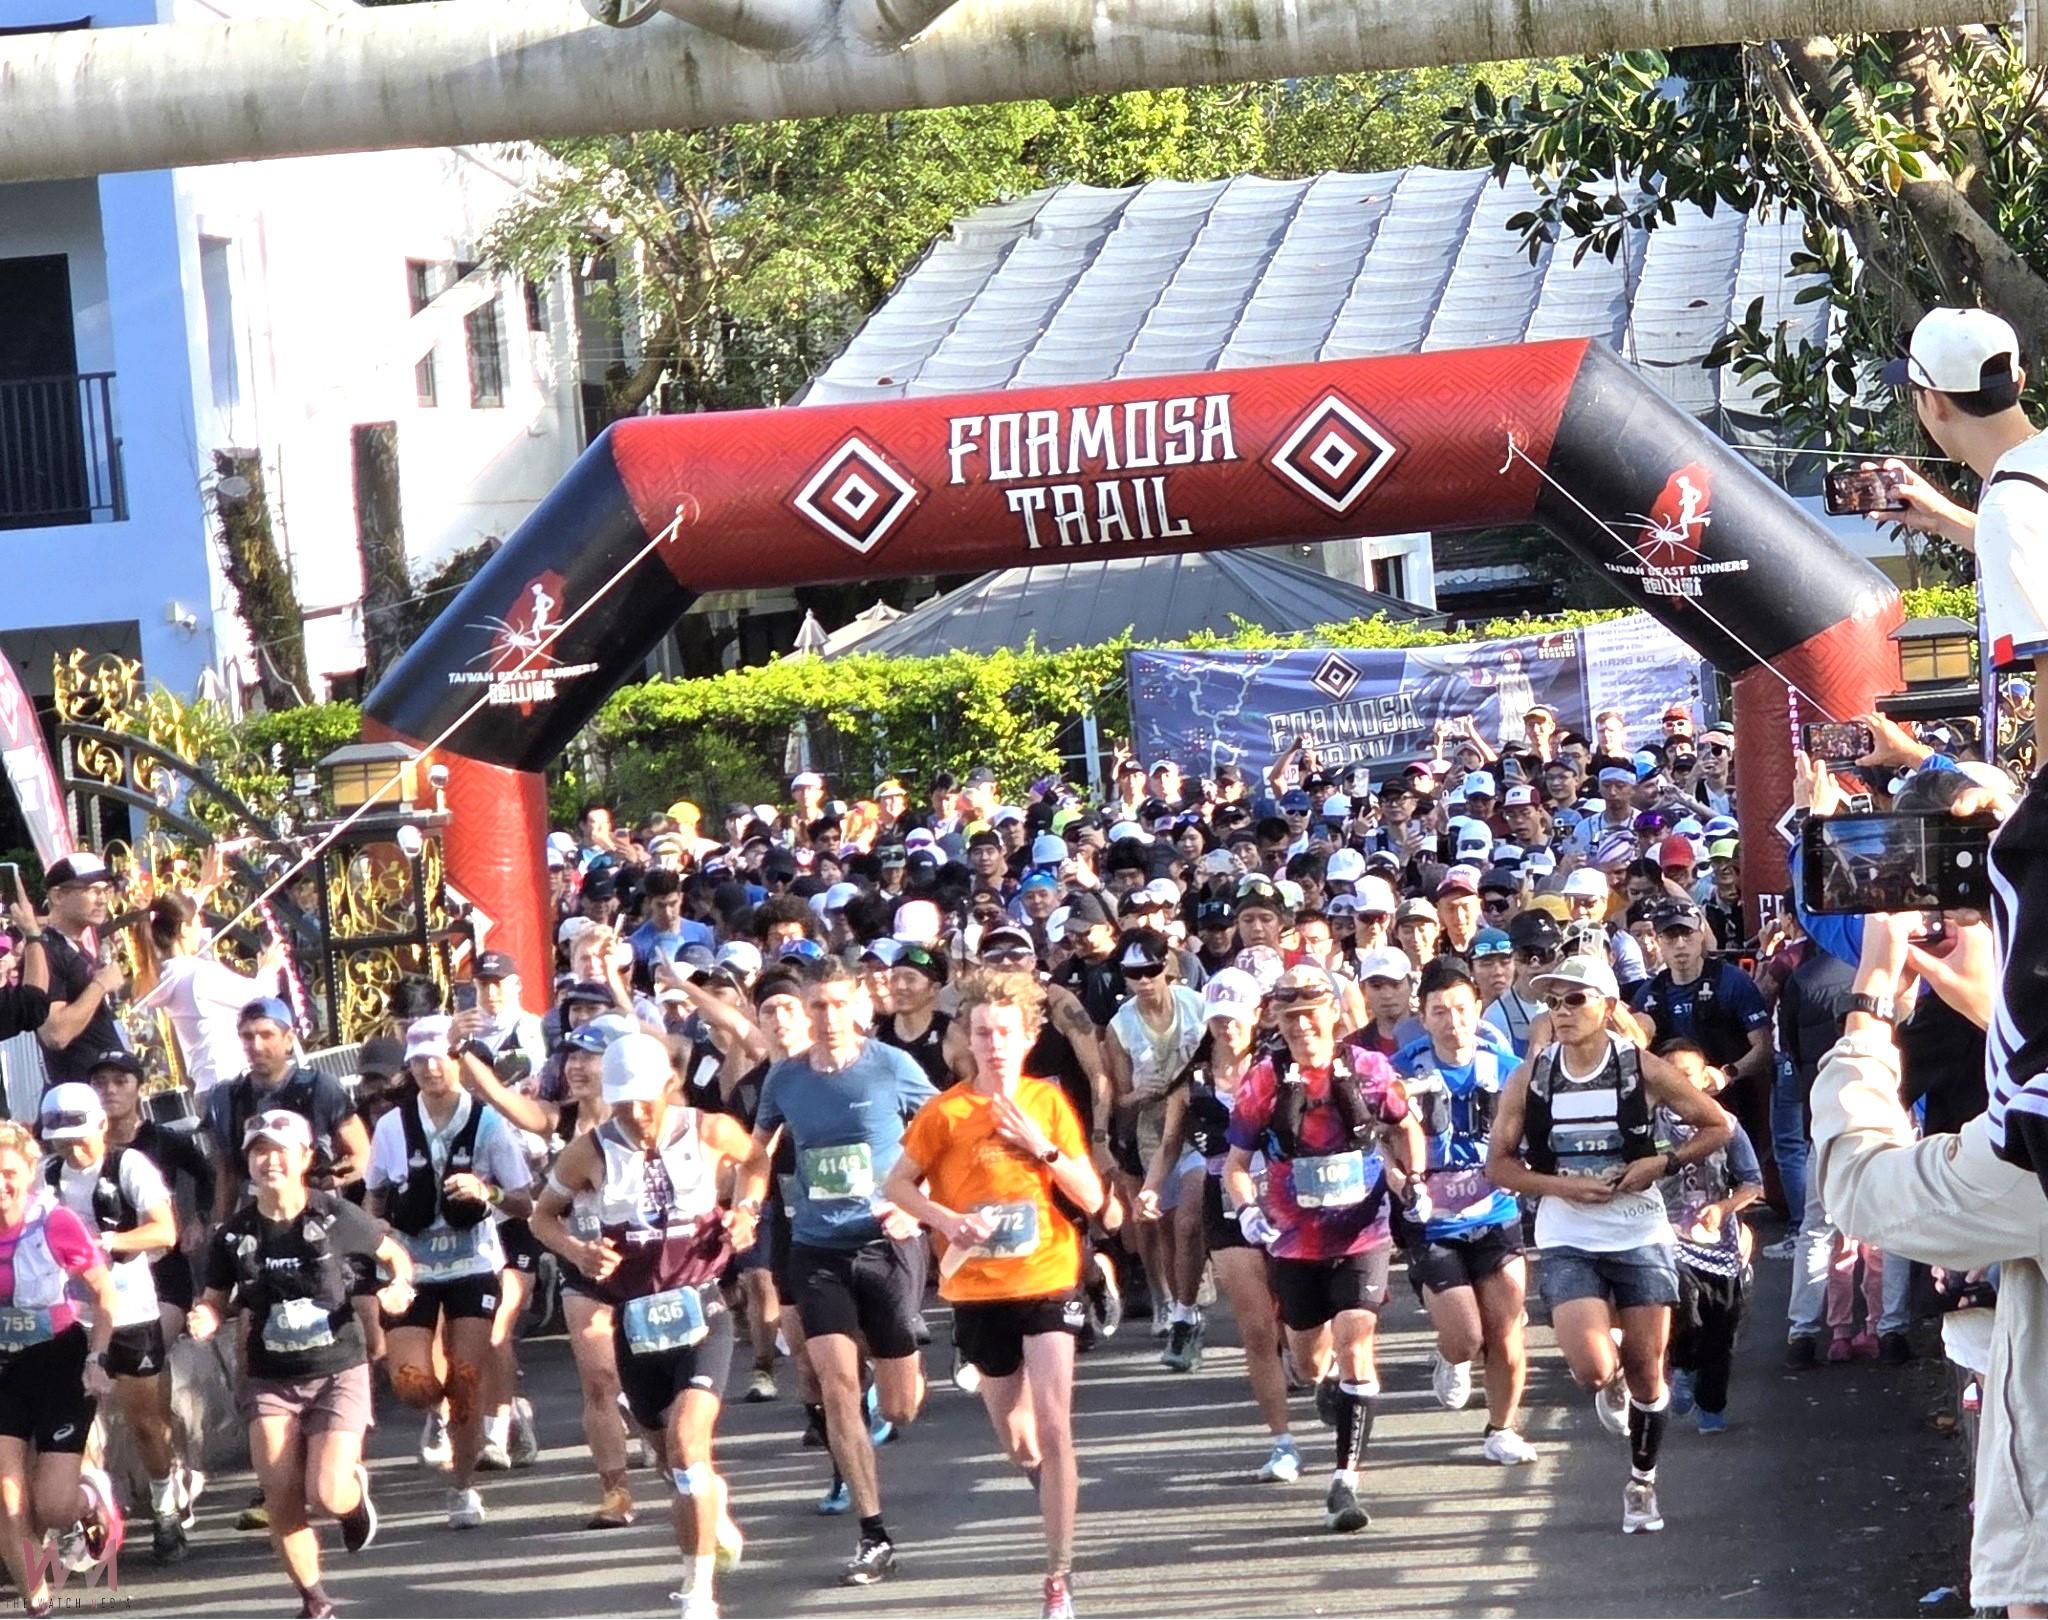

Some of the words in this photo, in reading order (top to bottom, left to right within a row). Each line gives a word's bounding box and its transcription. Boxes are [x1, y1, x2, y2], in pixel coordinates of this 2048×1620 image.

[948, 395, 1239, 483] FORMOSA
[1005, 476, 1194, 548] TRAIL
[1604, 562, 1645, 576] TAIWAN
[1689, 560, 1749, 575] RUNNERS
[448, 672, 494, 684] TAIWAN
[1268, 693, 1422, 753] FORMOSA
[1445, 1179, 1477, 1198] 810
[430, 1235, 457, 1253] 101
[647, 1301, 684, 1326] 436
[2, 1315, 36, 1334] 755
